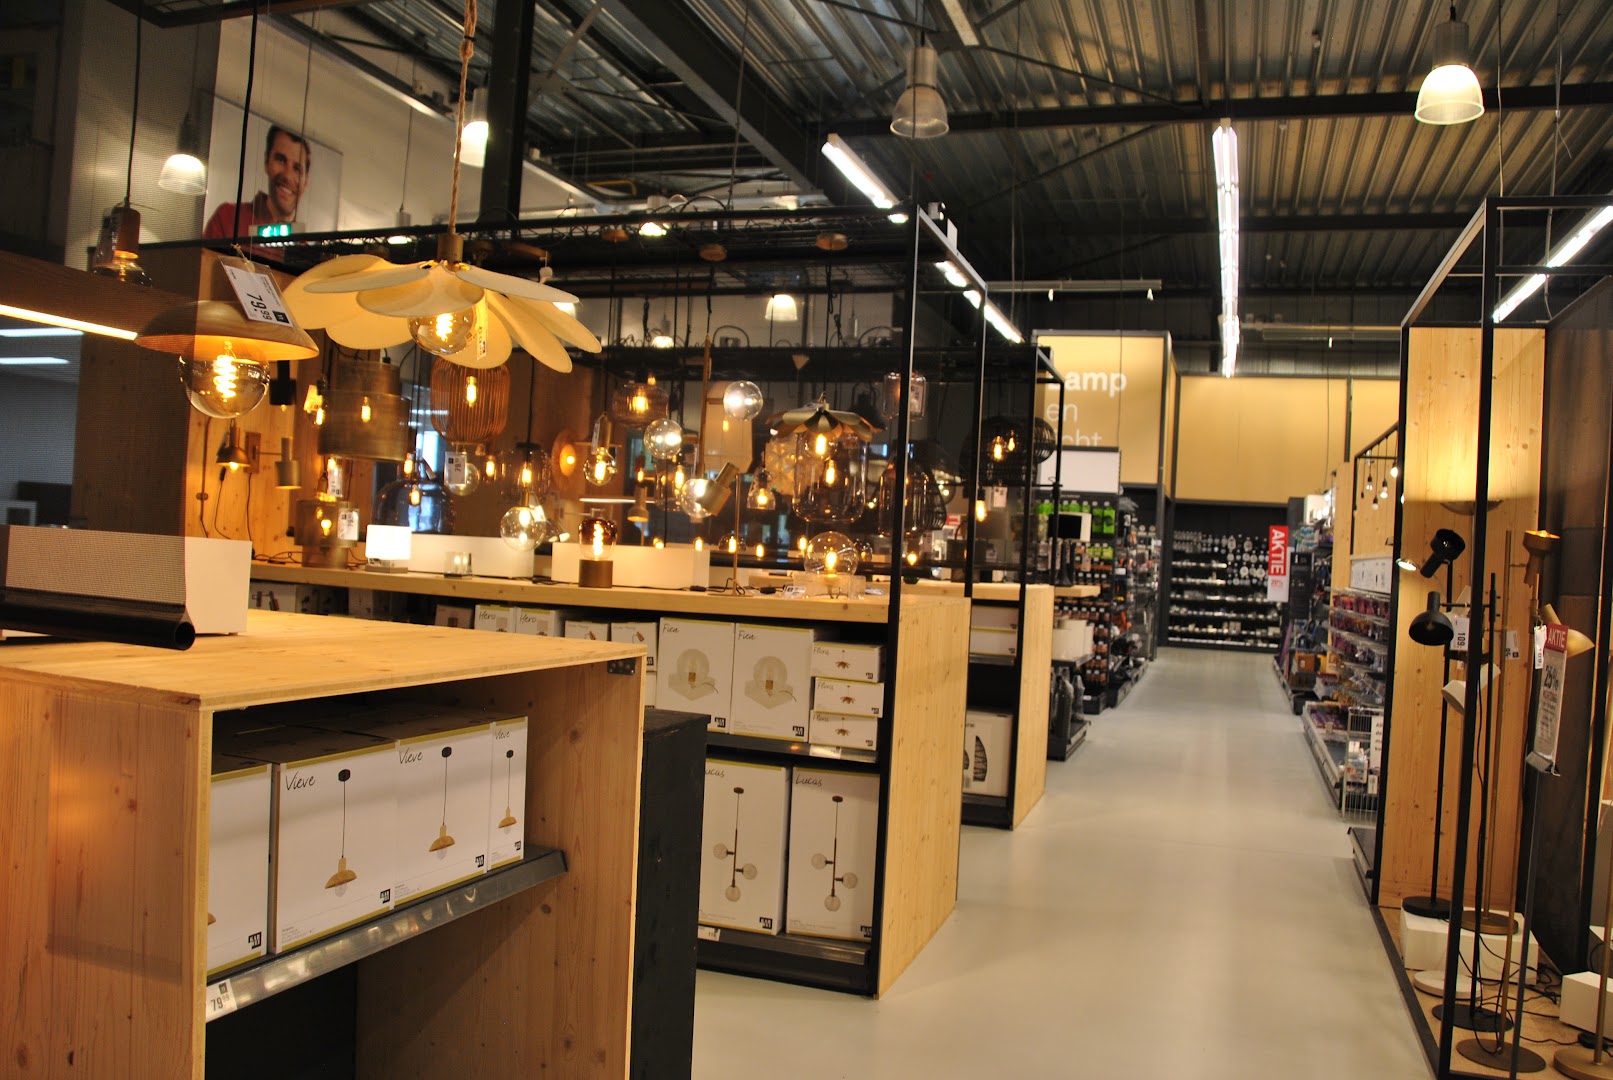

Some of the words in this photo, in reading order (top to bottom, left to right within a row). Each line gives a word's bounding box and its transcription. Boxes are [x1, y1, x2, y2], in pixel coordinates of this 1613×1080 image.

[1271, 528, 1286, 574] AKTIE
[478, 610, 497, 621] Hero
[519, 613, 537, 624] Hero
[1547, 627, 1567, 649] AKTIE
[400, 747, 424, 765] Vieve
[705, 767, 725, 778] ucas
[285, 771, 317, 792] Vieve
[795, 774, 823, 787] Lucas
